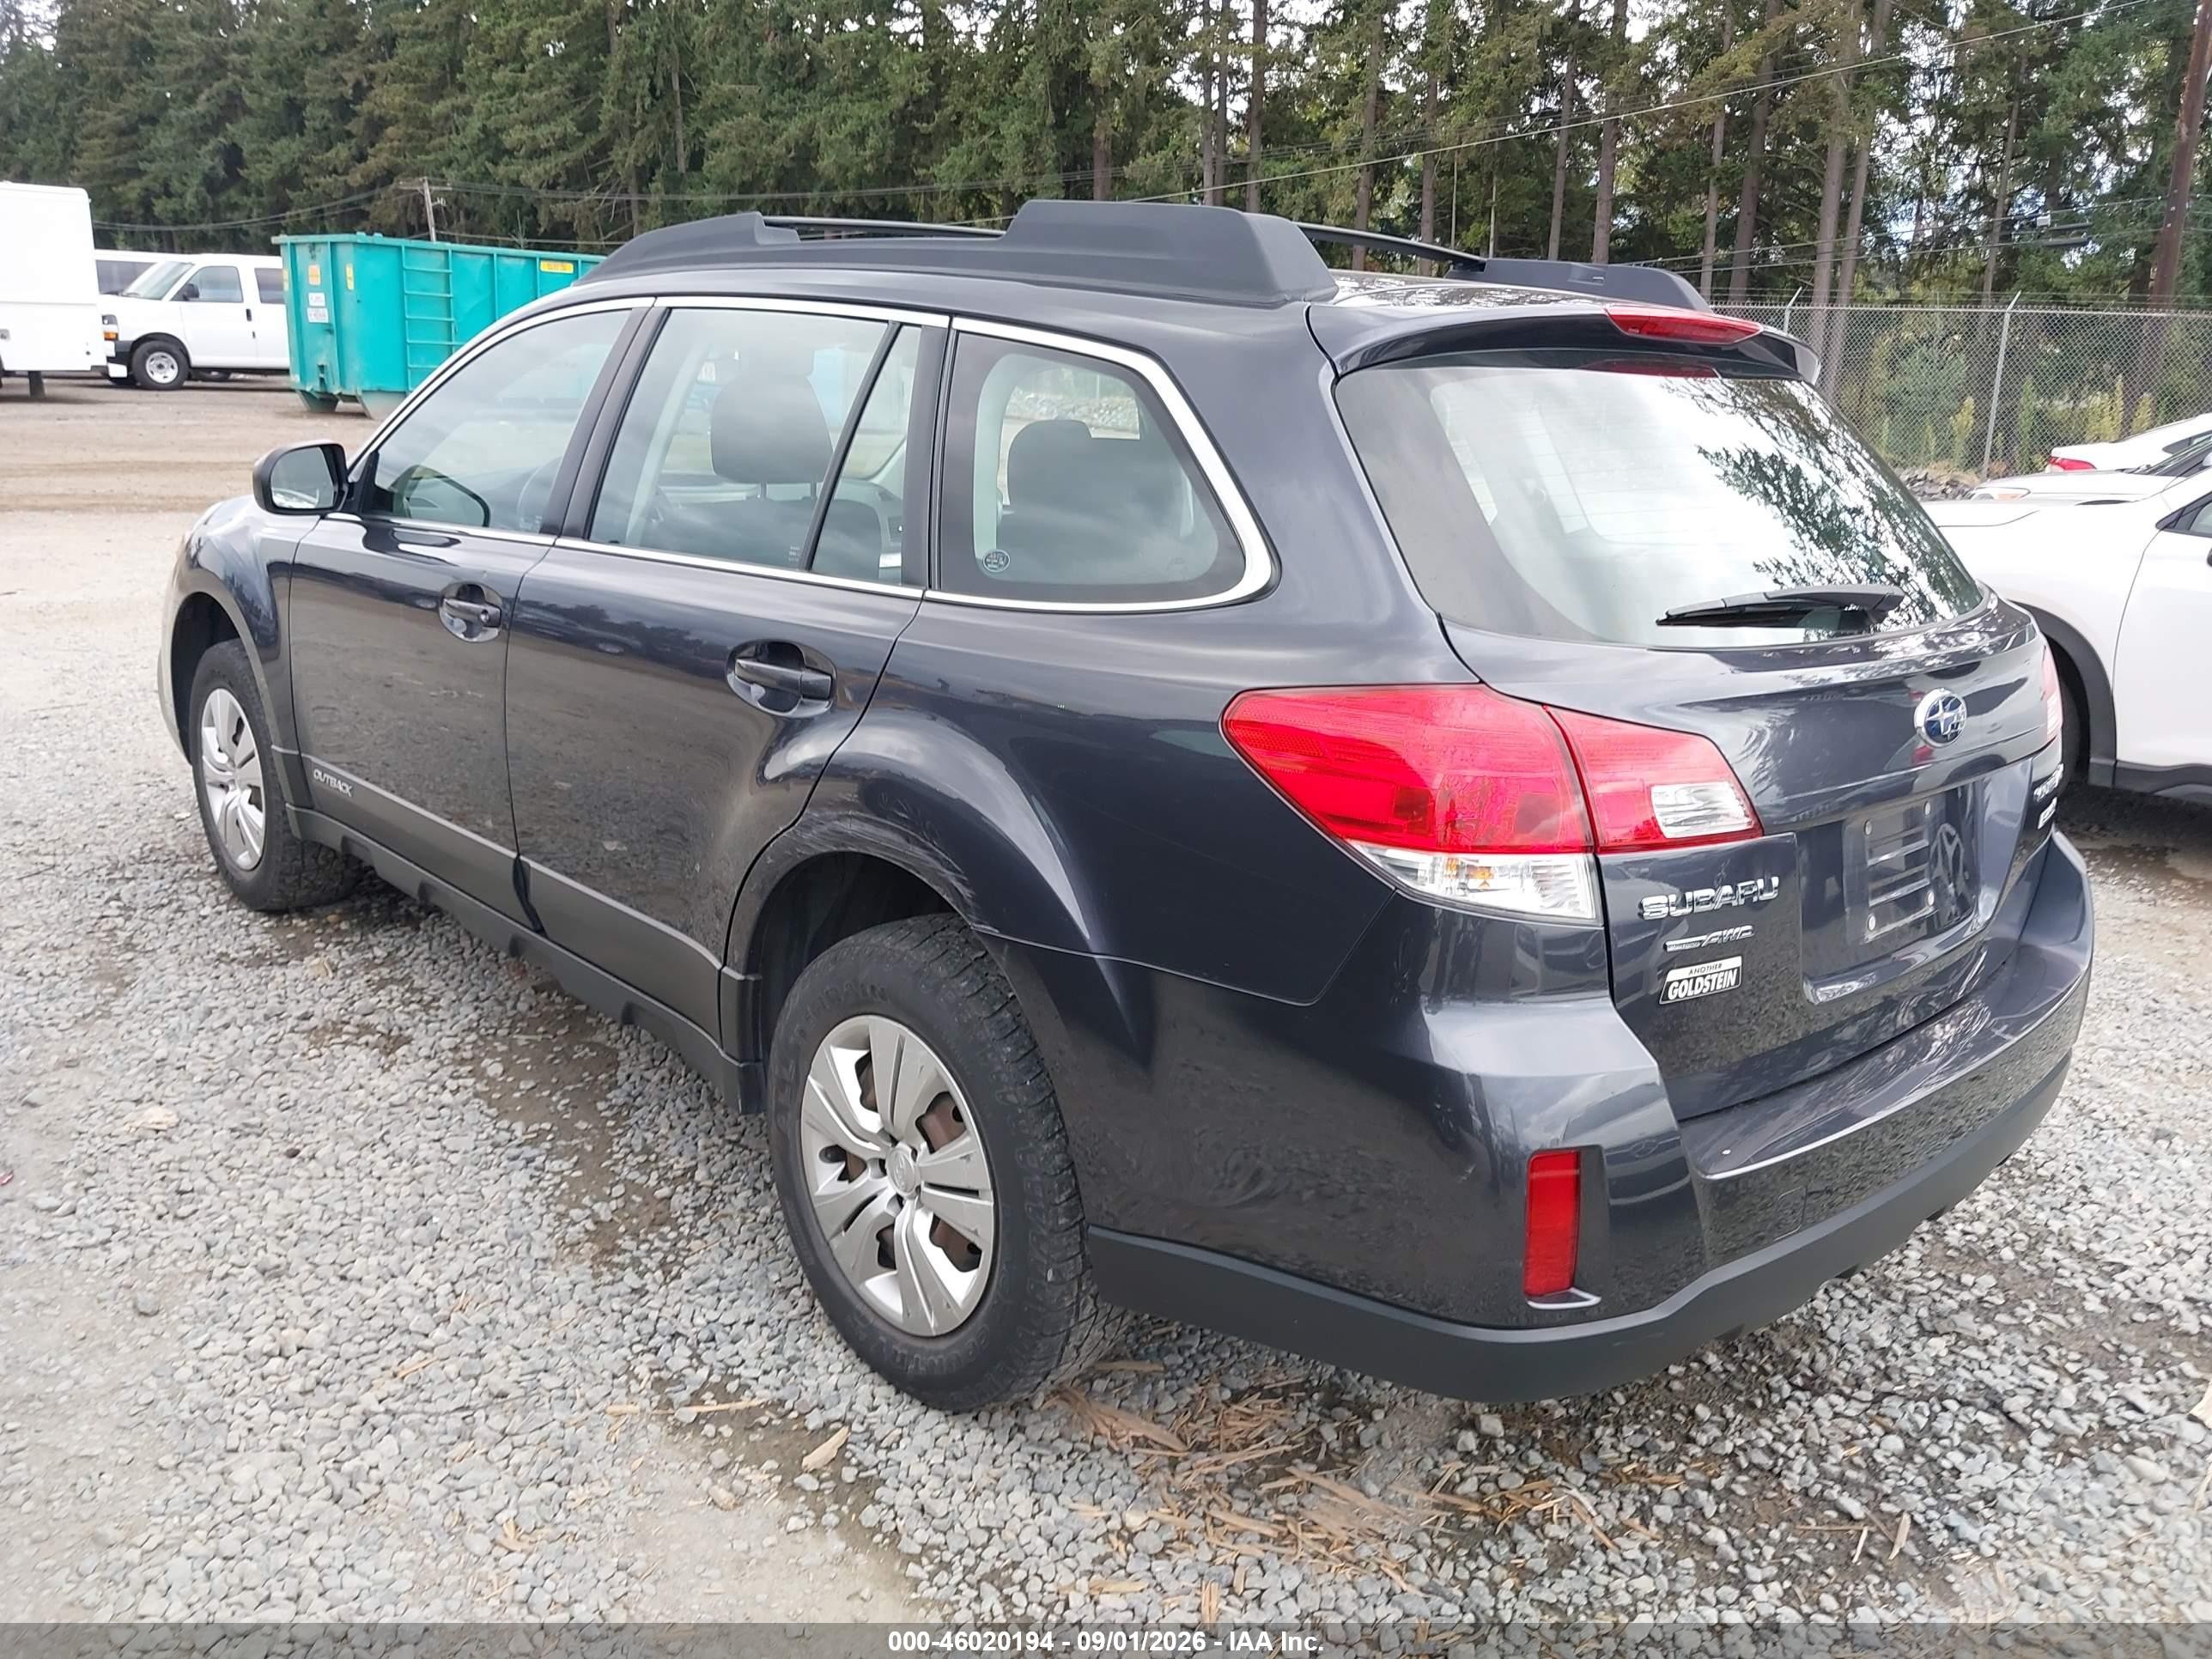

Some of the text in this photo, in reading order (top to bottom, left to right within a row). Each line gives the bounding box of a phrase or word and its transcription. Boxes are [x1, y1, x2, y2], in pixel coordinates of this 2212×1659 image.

[313, 769, 352, 797] OUTBACK
[1639, 876, 1779, 920] SUBARU
[1668, 968, 1738, 1000] GOLDSTEIN
[1688, 963, 1723, 975] ANOTHER
